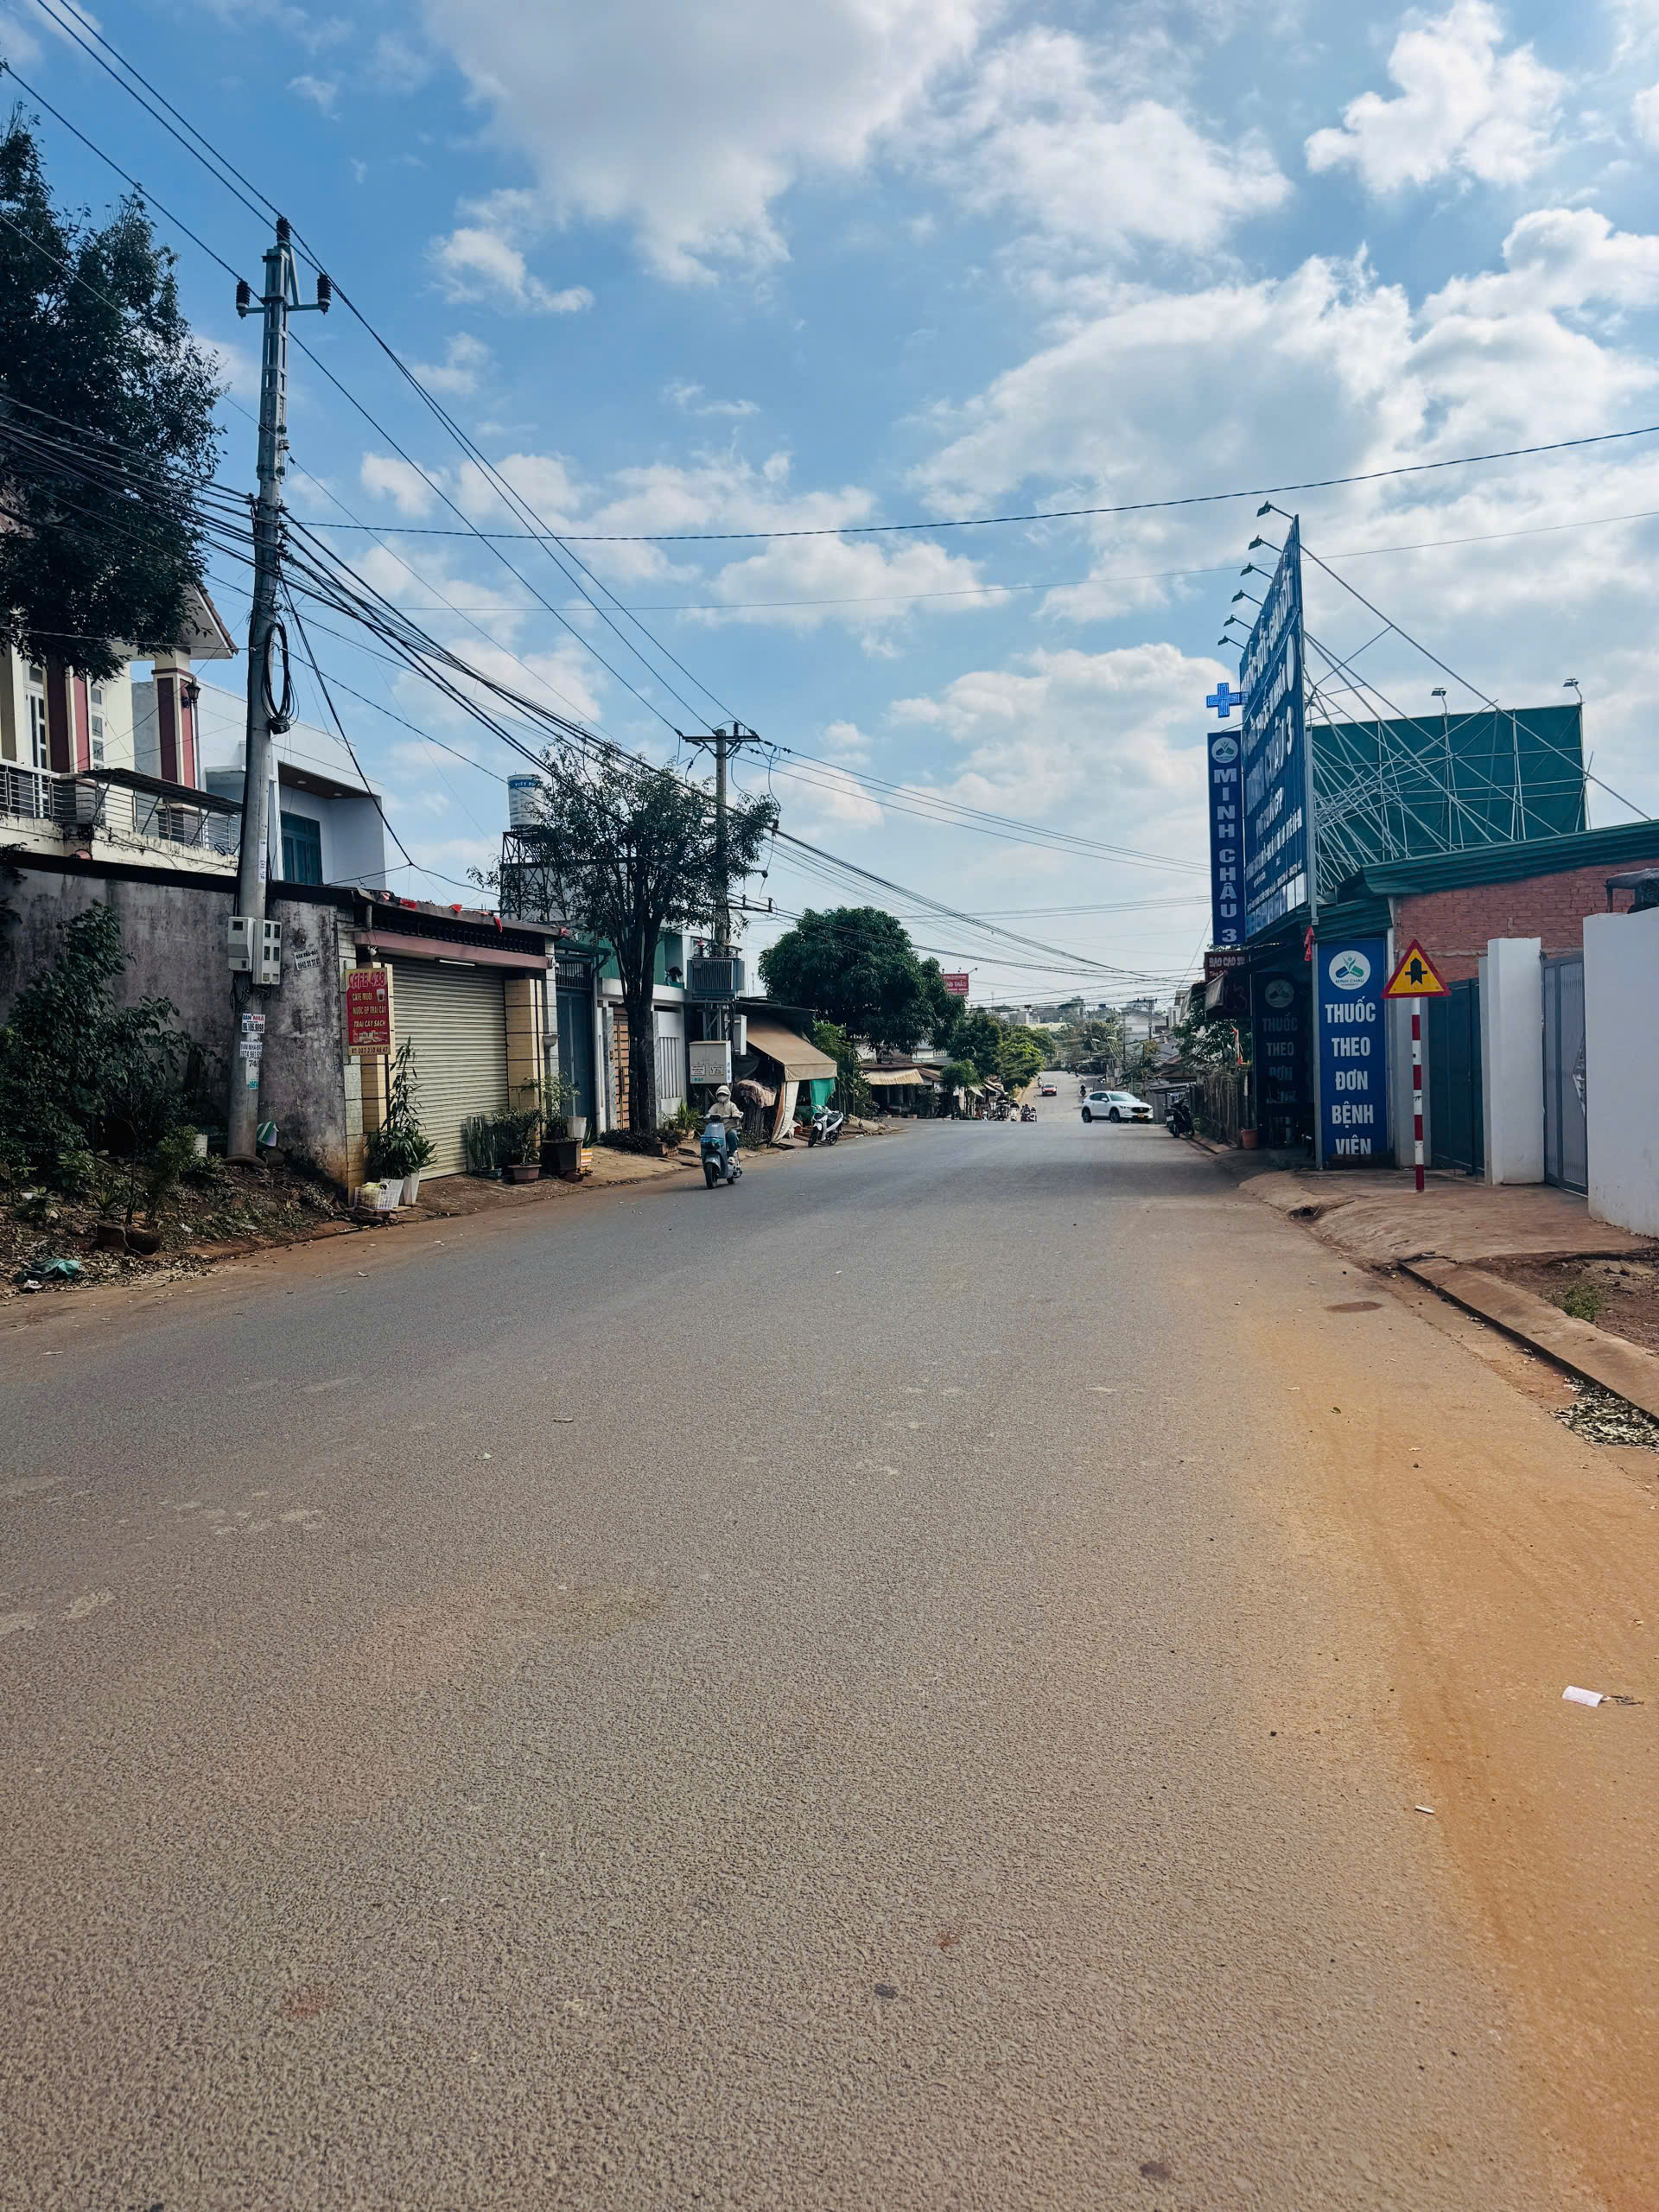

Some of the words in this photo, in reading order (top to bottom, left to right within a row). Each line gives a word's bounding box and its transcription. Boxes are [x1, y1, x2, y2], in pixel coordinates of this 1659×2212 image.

[1287, 706, 1294, 755] 3
[1214, 768, 1237, 838] MINH
[1218, 849, 1237, 918] CHÂU
[1221, 928, 1237, 943] 3
[1325, 995, 1376, 1024] THUỐC
[1262, 1012, 1298, 1033] THUỐC
[1266, 1042, 1294, 1057] THEO
[1332, 1037, 1370, 1057] THEO
[1335, 1069, 1369, 1090] ĐƠN
[1332, 1100, 1374, 1128] BỆNH
